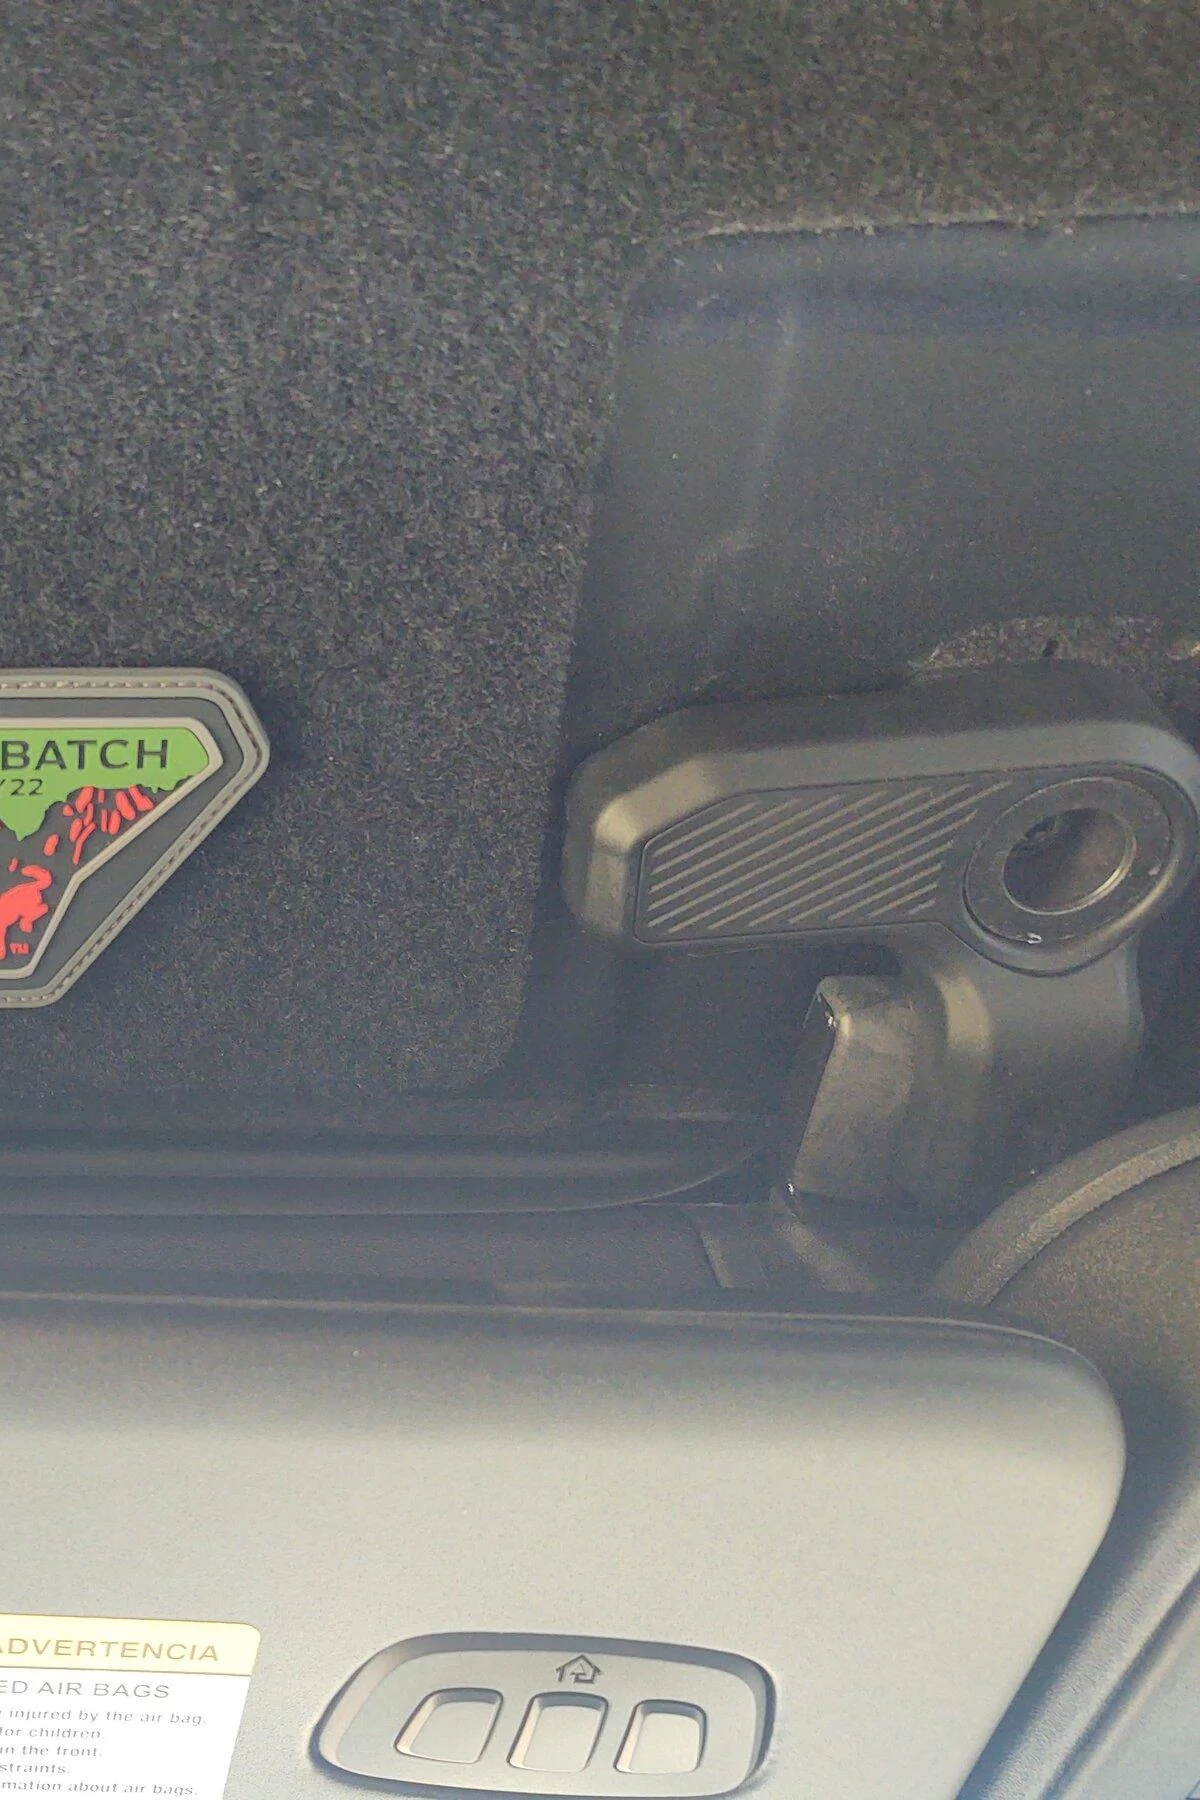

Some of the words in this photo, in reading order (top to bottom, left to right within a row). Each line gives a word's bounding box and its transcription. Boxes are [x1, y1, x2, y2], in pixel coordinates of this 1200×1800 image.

[0, 738, 170, 770] BATCH
[37, 1681, 83, 1696] AIR
[93, 1683, 170, 1699] BAGS
[9, 1708, 72, 1721] injured
[78, 1709, 99, 1723] by
[106, 1711, 133, 1723] the
[140, 1712, 163, 1723] air
[170, 1713, 207, 1727] bag.
[29, 1727, 105, 1740] children.
[0, 1745, 14, 1755] in
[22, 1745, 49, 1757] the
[68, 1781, 117, 1793] about
[124, 1784, 146, 1794] air
